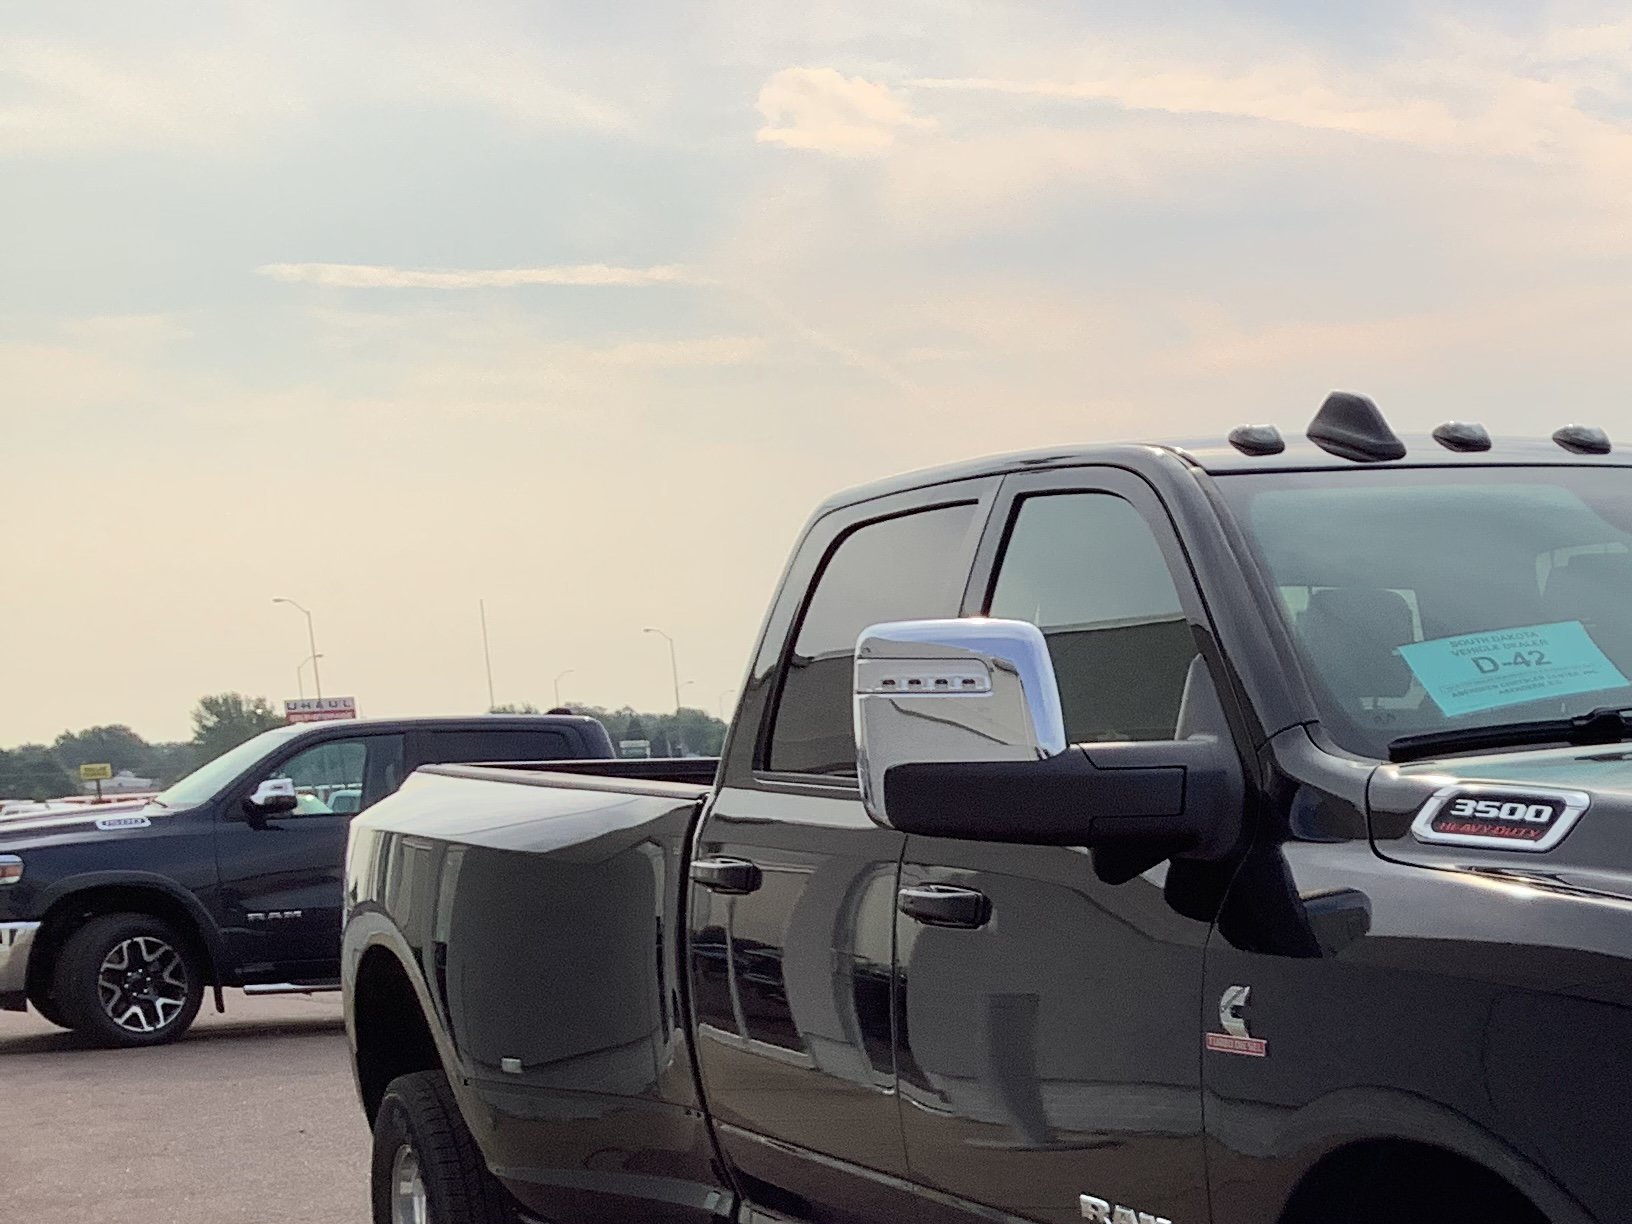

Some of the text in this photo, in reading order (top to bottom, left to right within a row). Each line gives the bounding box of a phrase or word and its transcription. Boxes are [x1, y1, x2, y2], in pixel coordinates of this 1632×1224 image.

[1450, 631, 1540, 648] SOUTH DAKOTA
[1451, 639, 1550, 657] VEHICLE DEALER
[1471, 650, 1552, 674] D-42
[1450, 798, 1553, 823] 3500
[1439, 822, 1543, 838] HEAVY DUTY
[247, 910, 302, 921] RAM
